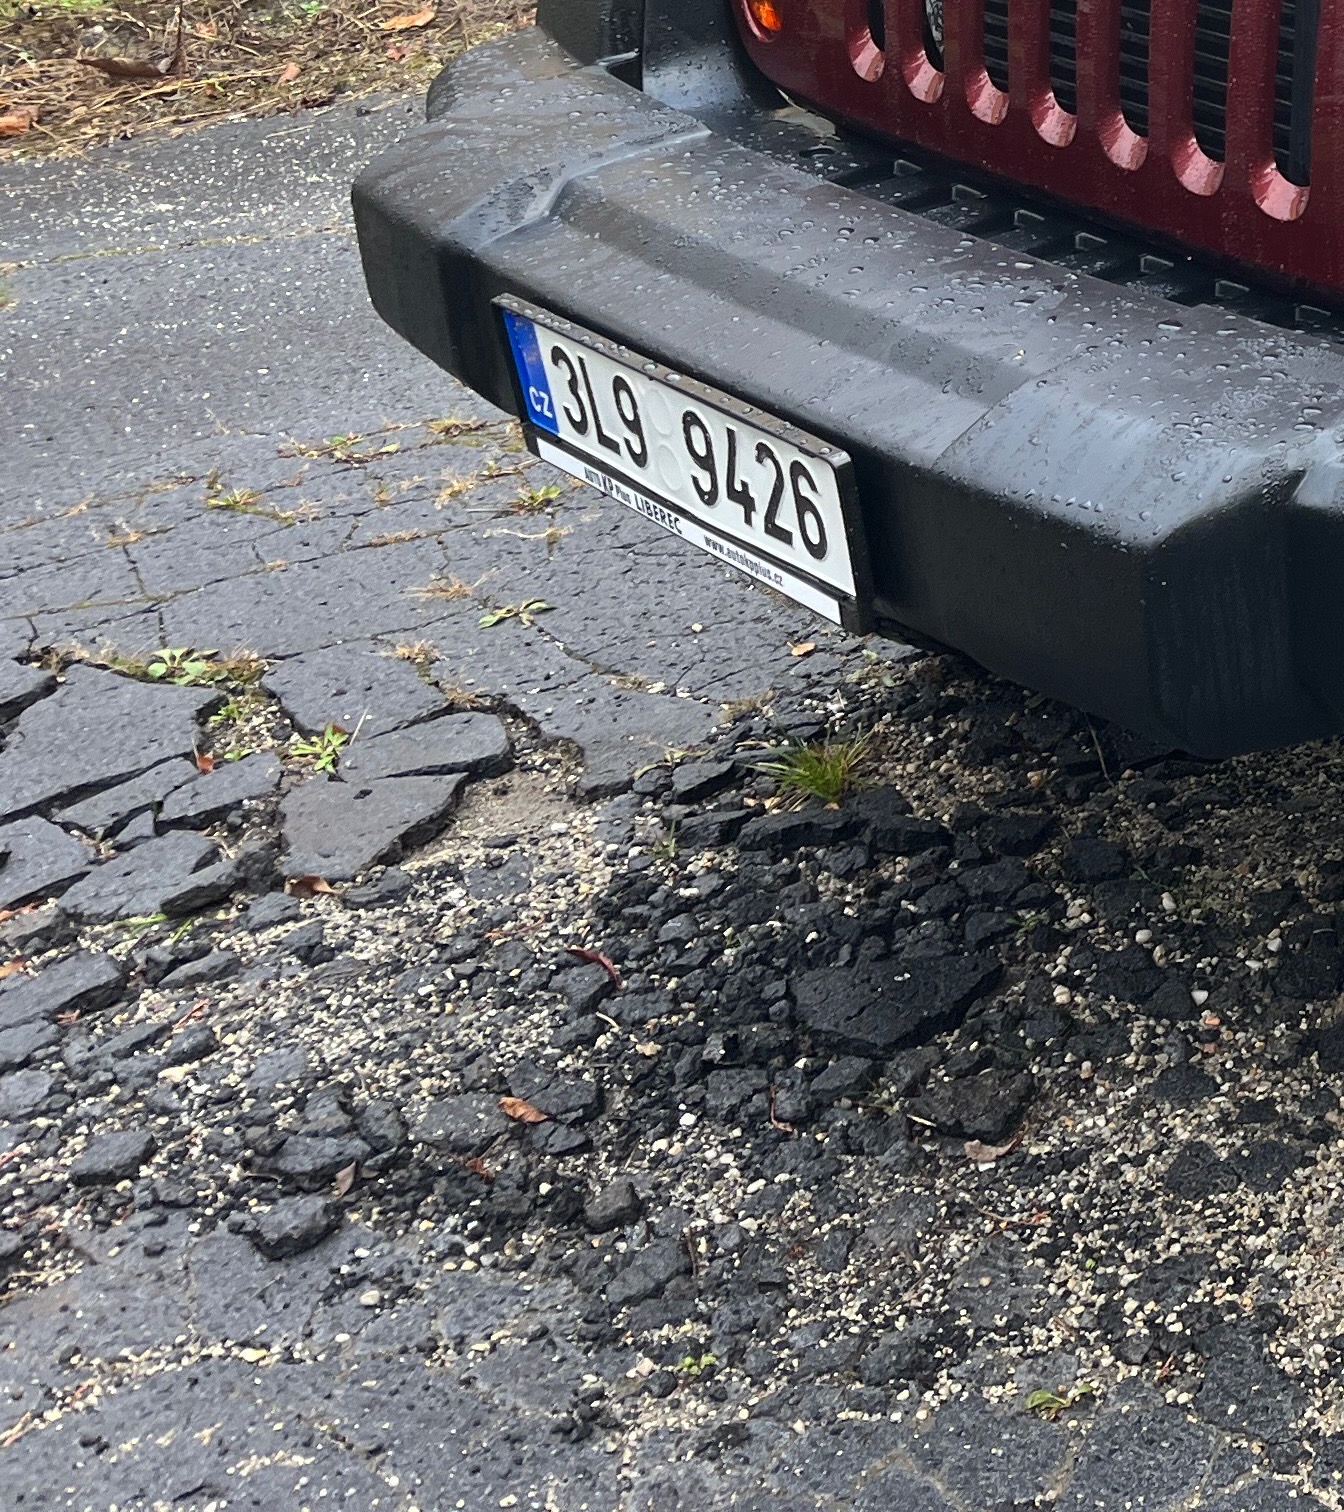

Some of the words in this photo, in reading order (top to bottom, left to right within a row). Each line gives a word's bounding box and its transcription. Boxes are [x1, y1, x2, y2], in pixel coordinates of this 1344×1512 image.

[529, 386, 553, 418] CZ
[551, 345, 648, 468] 3L9
[682, 410, 828, 560] 9426
[634, 493, 683, 535] LIBEREC
[703, 534, 784, 587] www.autokpplus.cz
